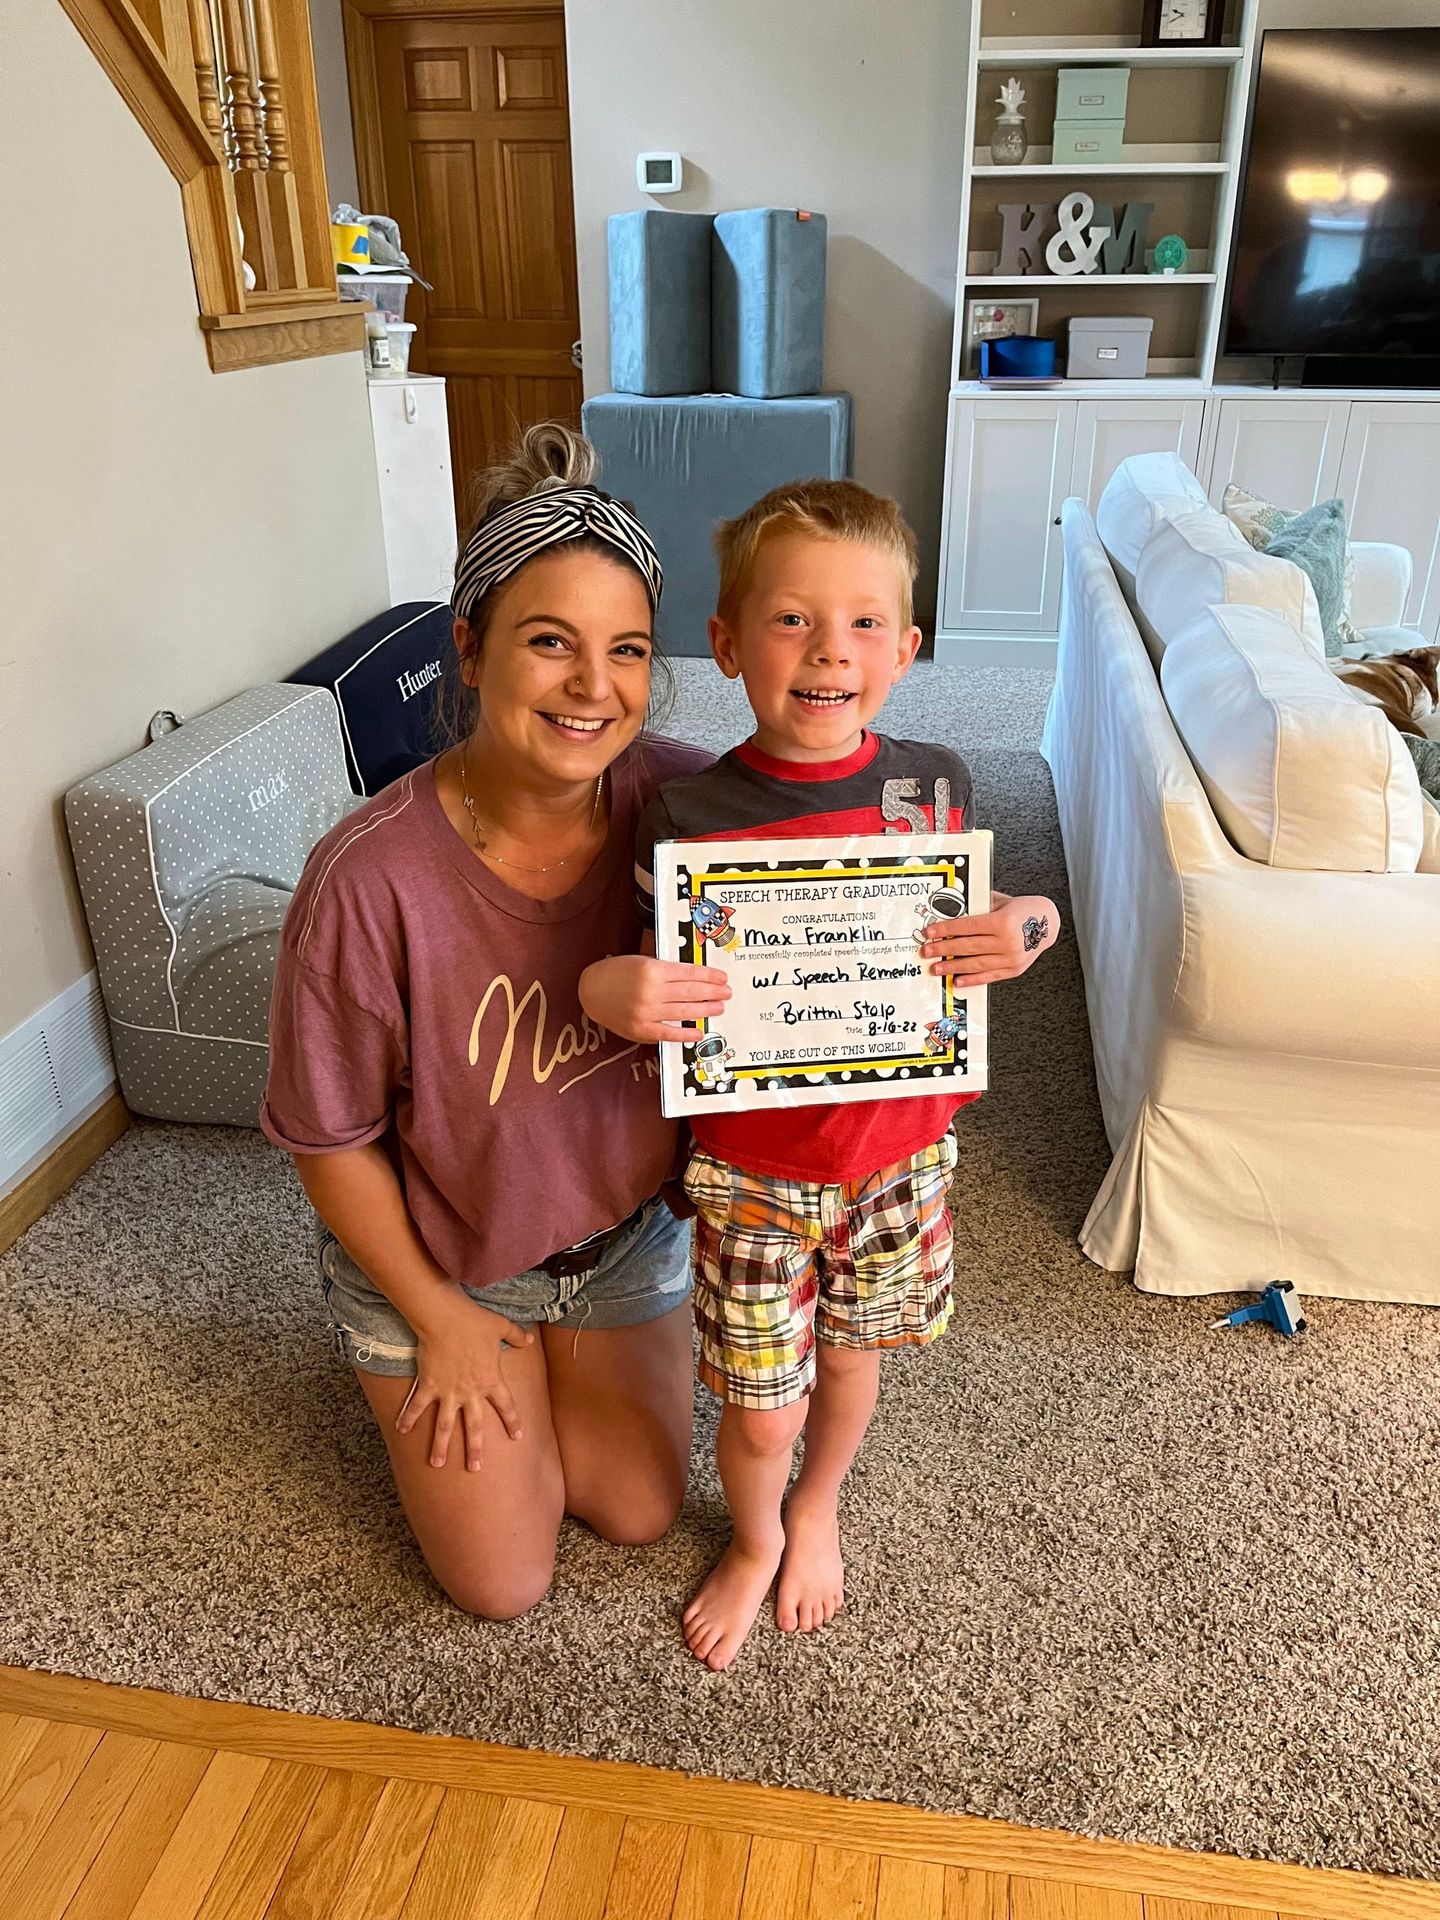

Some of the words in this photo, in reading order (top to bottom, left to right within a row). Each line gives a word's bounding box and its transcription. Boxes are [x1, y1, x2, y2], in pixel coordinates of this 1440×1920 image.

[993, 204, 1049, 275] K
[1046, 191, 1111, 275] &
[396, 660, 442, 702] Hunter
[881, 777, 950, 835] 51
[719, 889, 771, 904] SPEECH
[774, 886, 839, 902] THERAPY
[782, 911, 877, 925] CONGRATULATIONS!
[804, 925, 886, 946] Franklin
[734, 951, 746, 961] has
[748, 950, 791, 961] successfully
[793, 947, 832, 960] completed
[792, 966, 850, 991] Speech
[856, 962, 922, 981] Remedies
[853, 1000, 896, 1020] Stolp
[846, 1026, 863, 1035] Date
[867, 1021, 917, 1037] 8-16-22
[749, 1050, 771, 1062] YOU
[774, 1048, 796, 1061] ARE
[799, 1046, 821, 1059] OUT
[823, 1045, 839, 1057] OF
[842, 1043, 866, 1056] THIS
[868, 1040, 906, 1054] WORLD!
